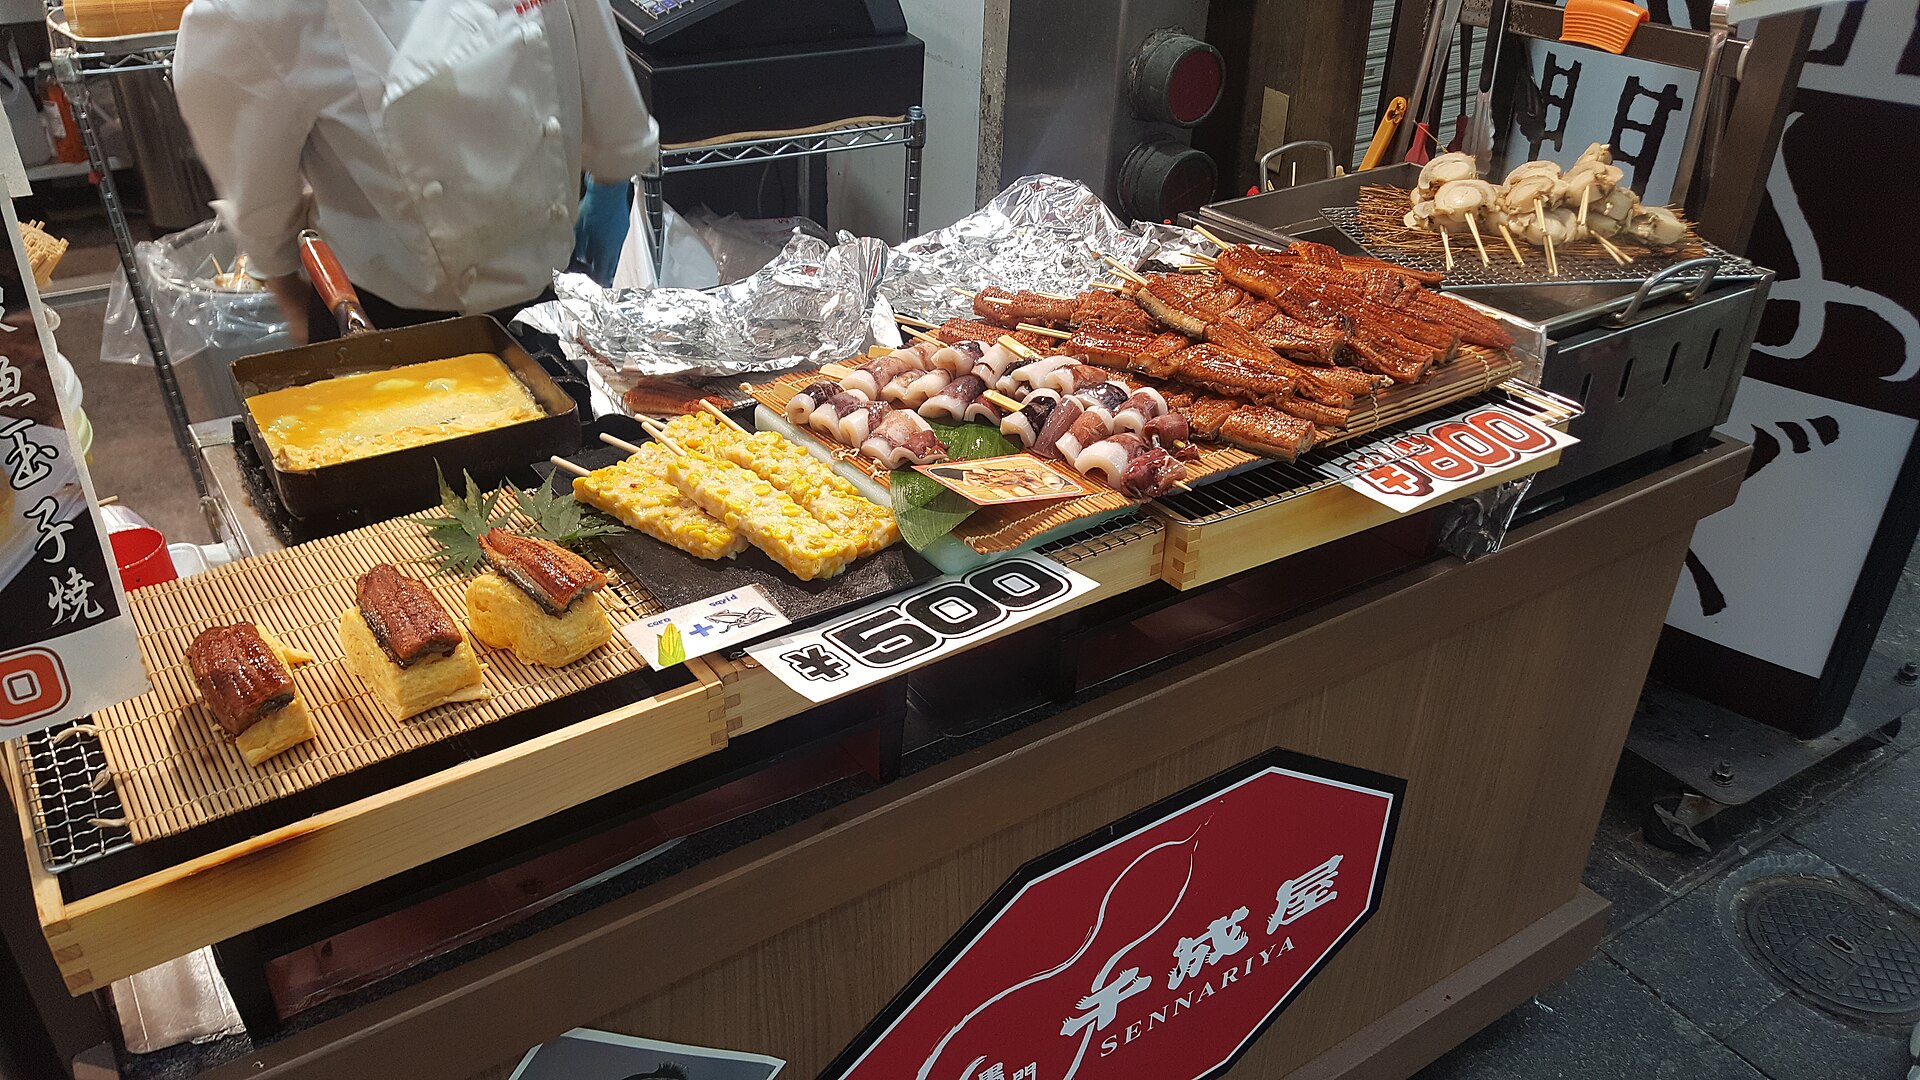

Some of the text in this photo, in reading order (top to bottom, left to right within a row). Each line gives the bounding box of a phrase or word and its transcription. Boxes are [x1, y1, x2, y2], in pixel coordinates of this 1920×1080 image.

[0, 286, 105, 626] 魚玉子焼
[779, 558, 1072, 683] ¥500
[1100, 936, 1296, 1058] SENNARIYA
